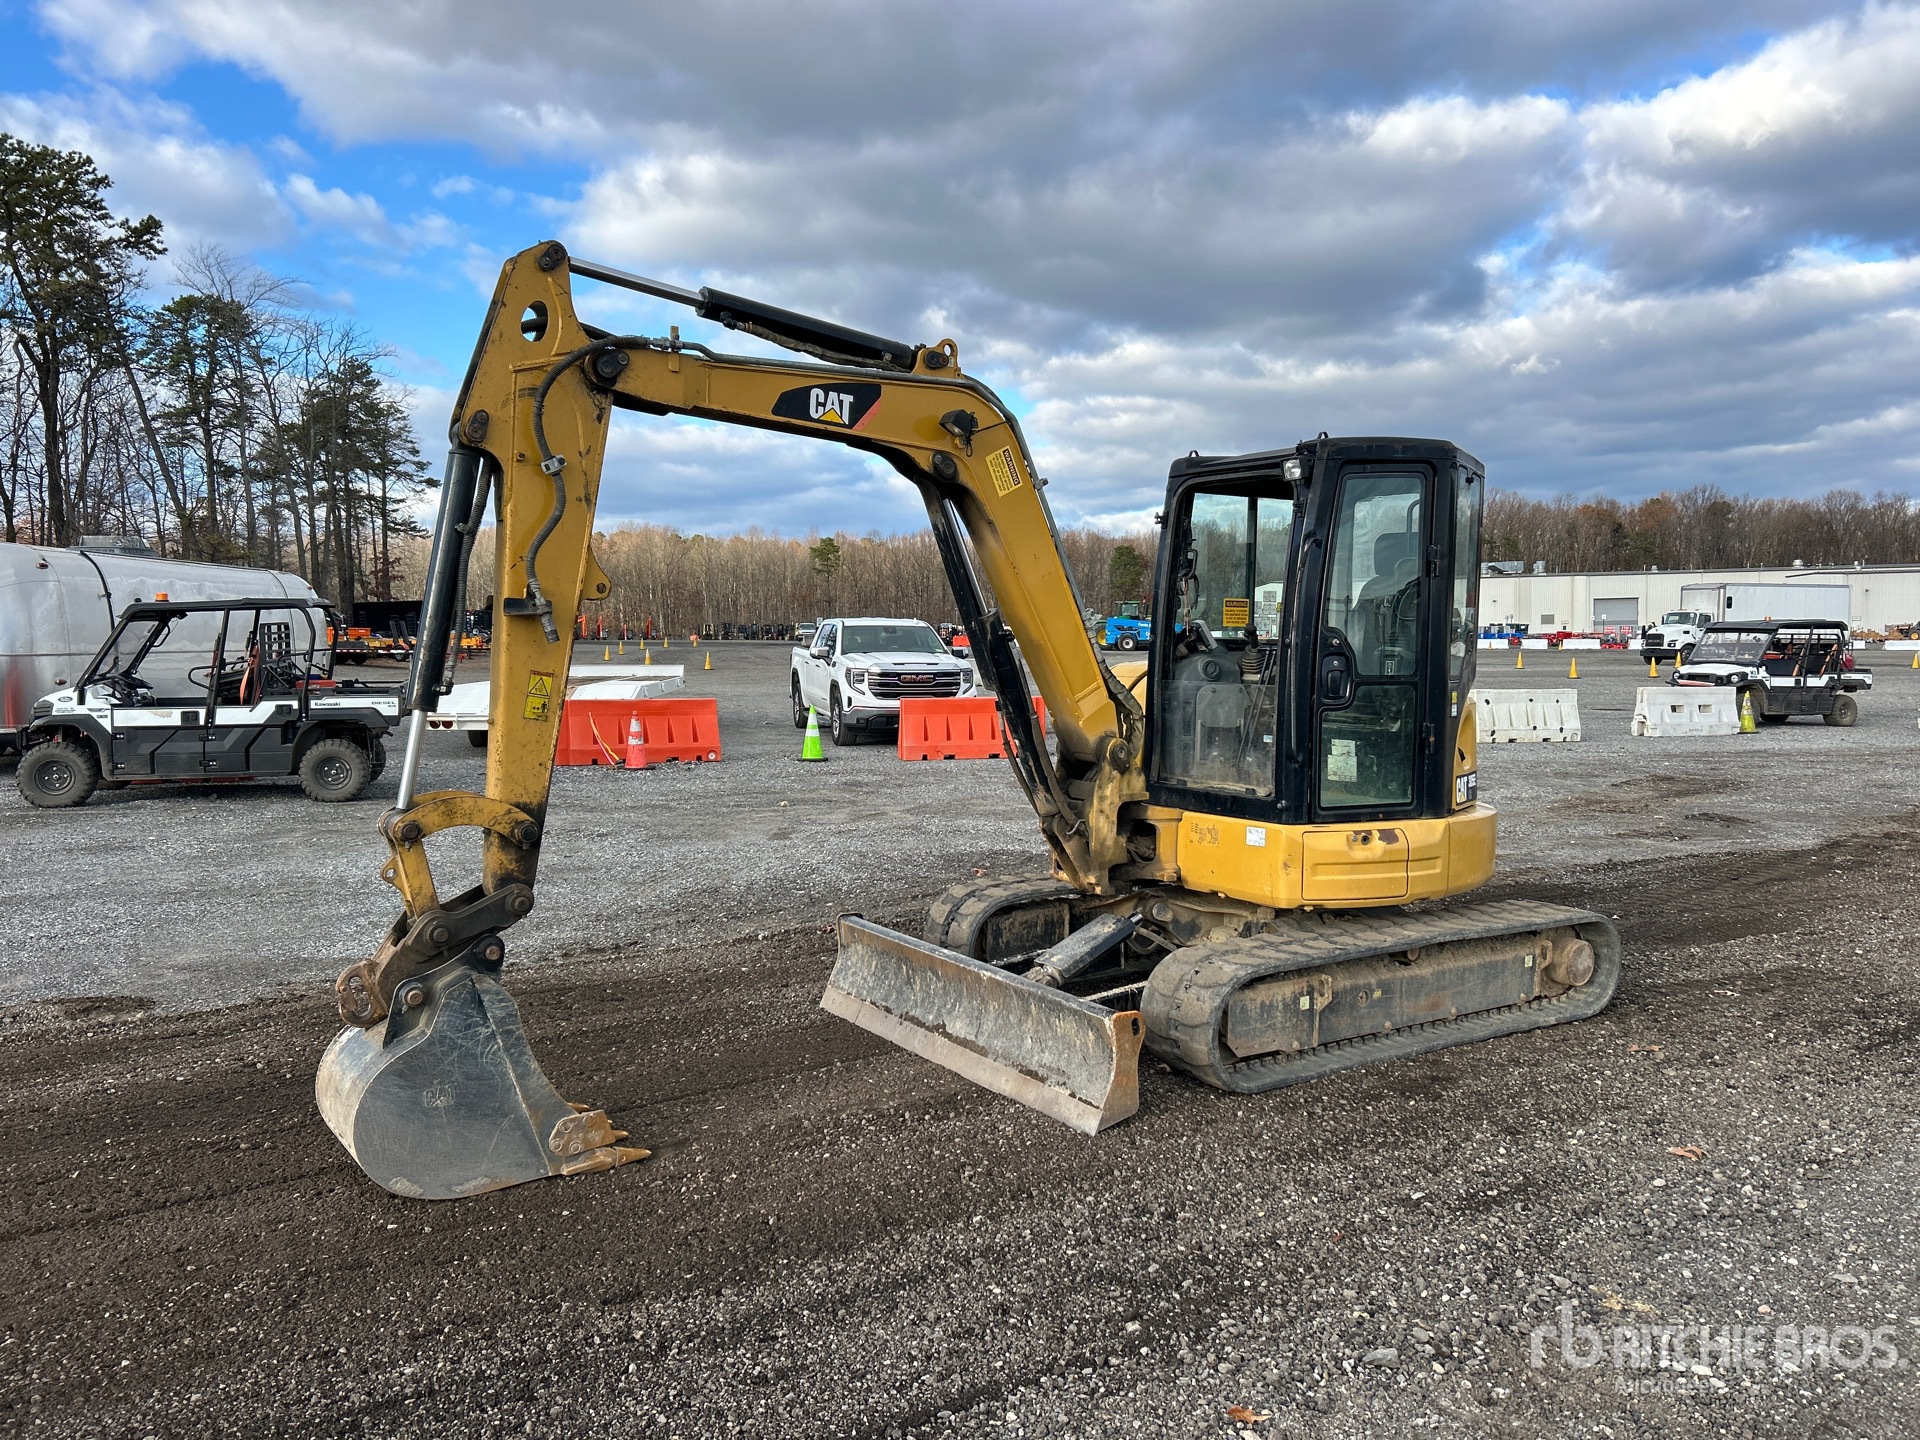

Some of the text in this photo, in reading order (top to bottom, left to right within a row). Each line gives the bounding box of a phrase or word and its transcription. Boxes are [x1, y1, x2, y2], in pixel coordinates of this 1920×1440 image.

[809, 388, 853, 425] CAT
[1004, 450, 1019, 485] WARNING
[1457, 776, 1468, 803] CAT
